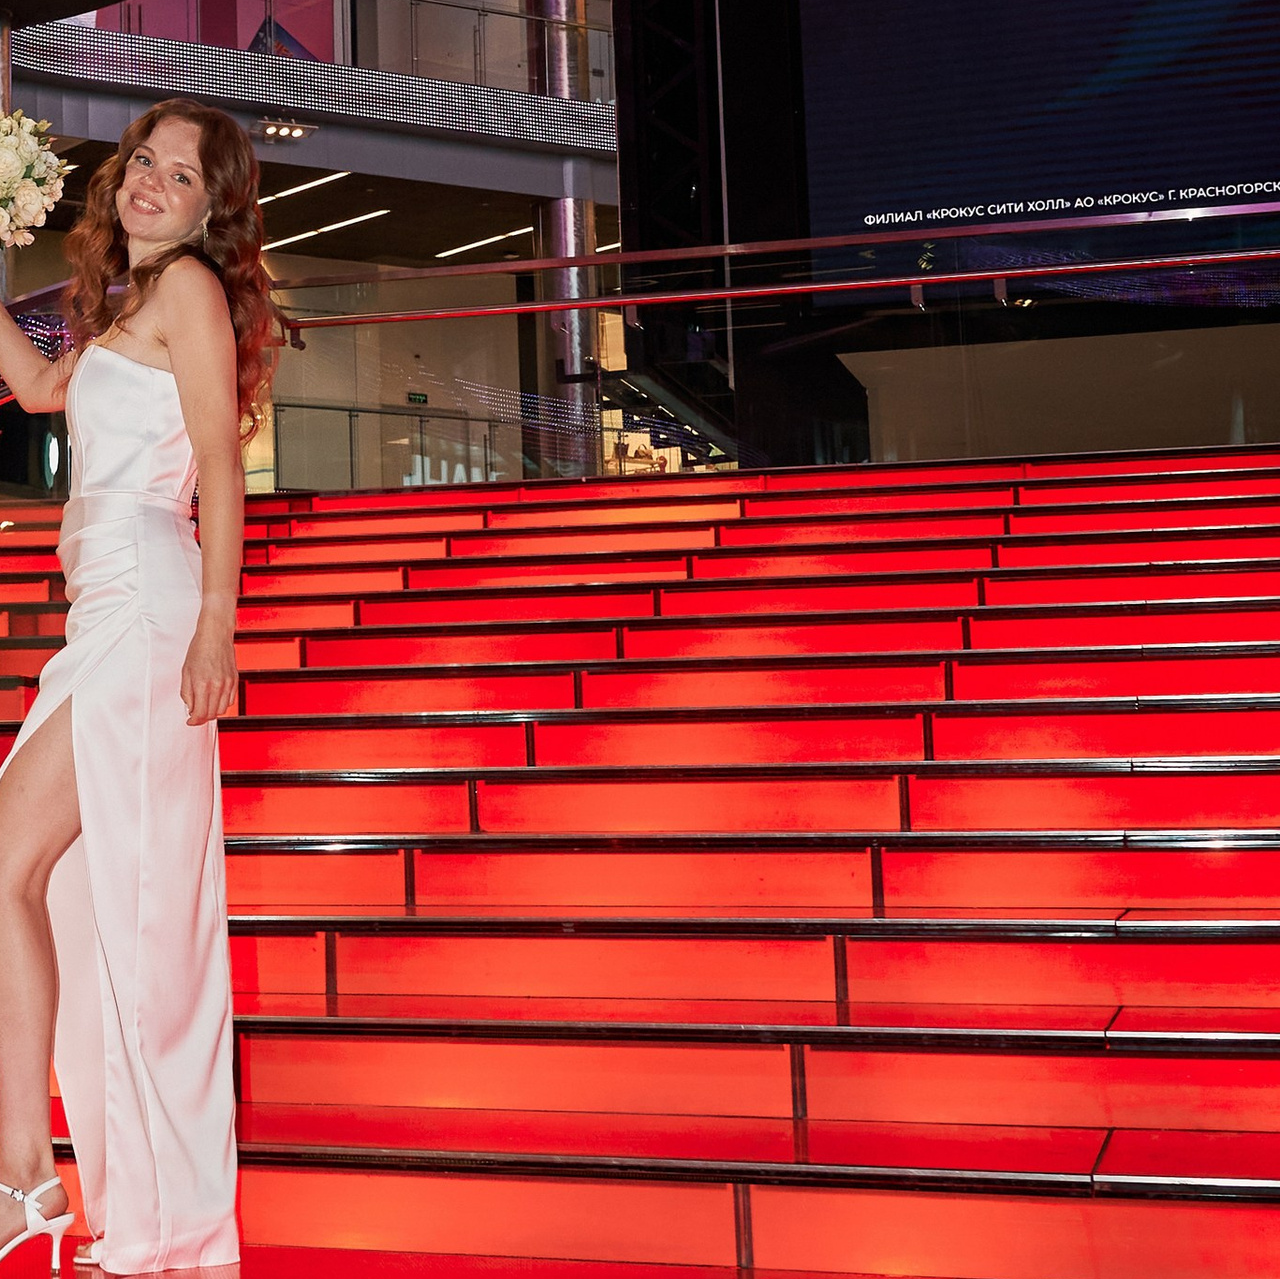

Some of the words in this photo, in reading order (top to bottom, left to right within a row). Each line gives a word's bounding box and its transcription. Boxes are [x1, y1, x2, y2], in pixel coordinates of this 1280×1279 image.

[863, 210, 924, 226] ФИЛИАЛ
[926, 205, 985, 220] «КРОКУС
[987, 202, 1024, 216] СИТИ
[1027, 198, 1071, 212] ХОЛЛ»
[1074, 196, 1094, 209] АО
[1097, 191, 1165, 206] «КРОКУС»
[1168, 189, 1177, 201] Г.
[1180, 181, 1280, 200] КРАСНОГОРСК
